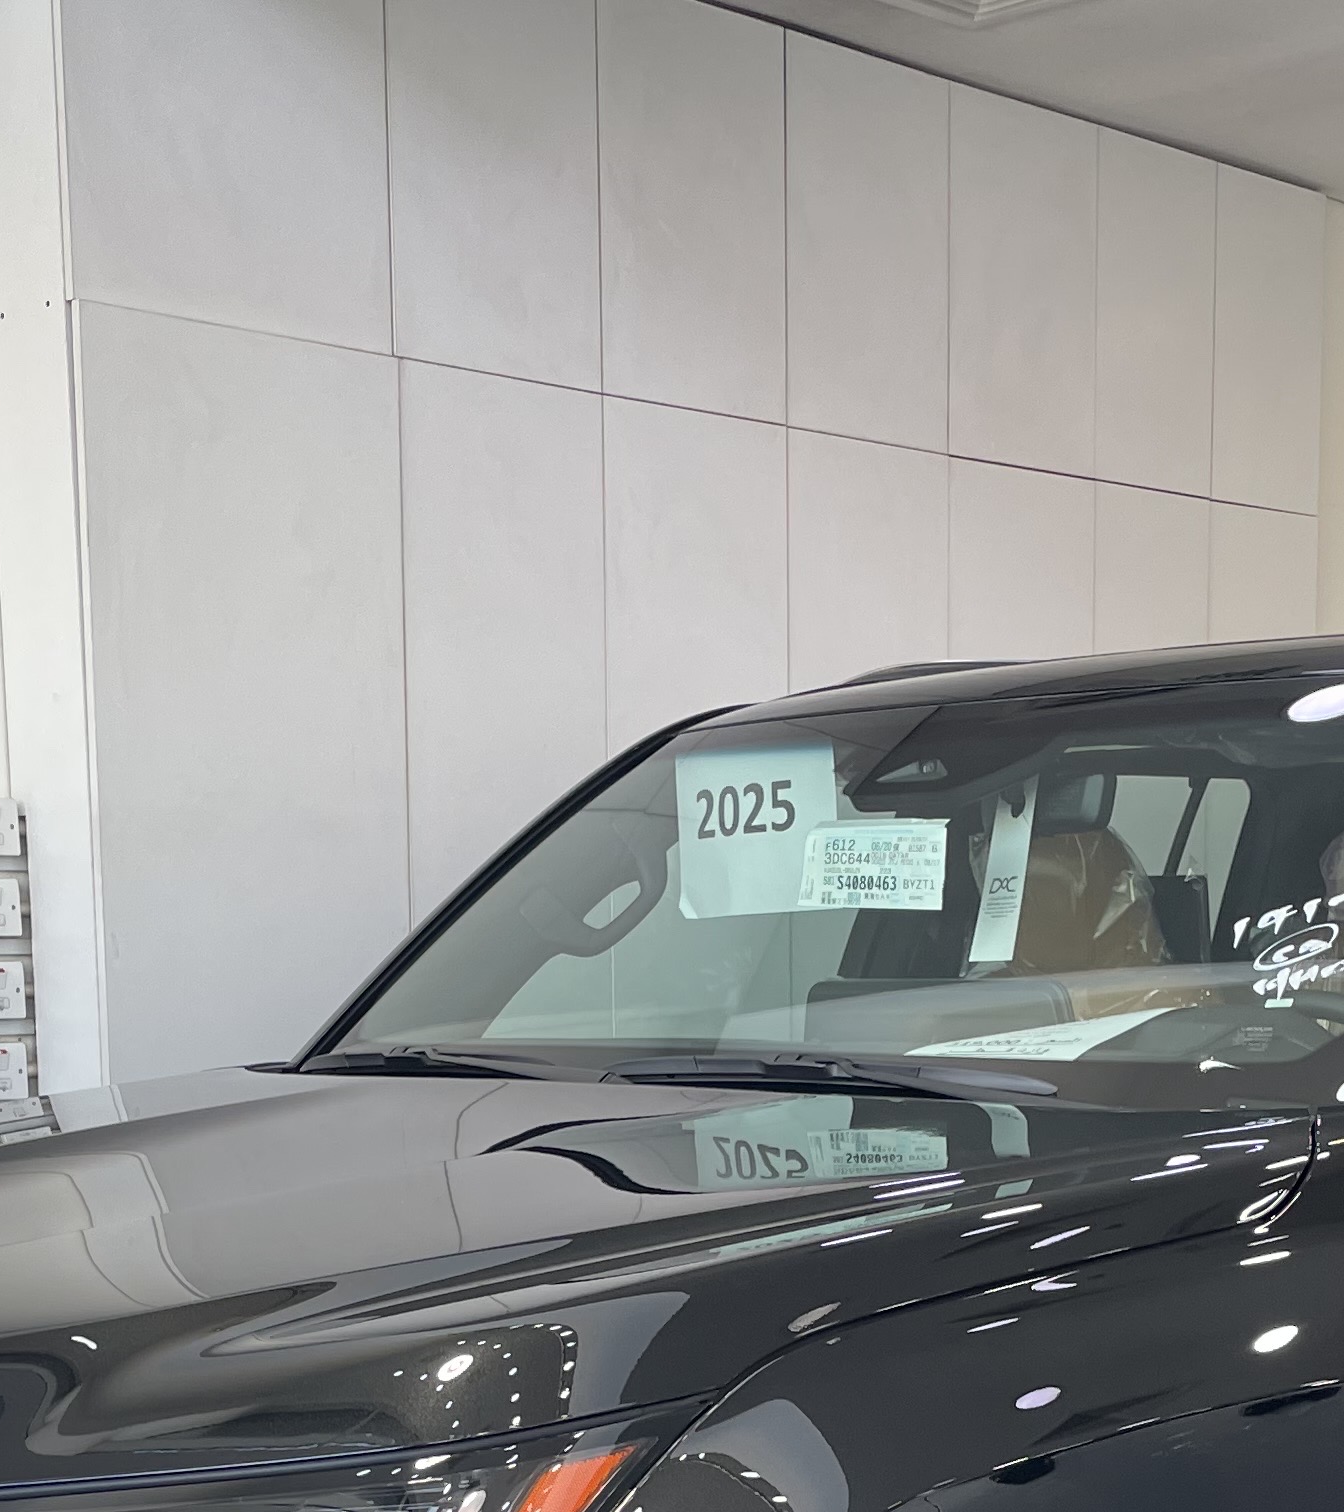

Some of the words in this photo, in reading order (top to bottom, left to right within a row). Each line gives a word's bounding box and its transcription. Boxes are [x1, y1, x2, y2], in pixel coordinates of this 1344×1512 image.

[696, 780, 796, 840] 2025
[824, 853, 871, 865] 3DC644
[837, 875, 897, 891] S4080463
